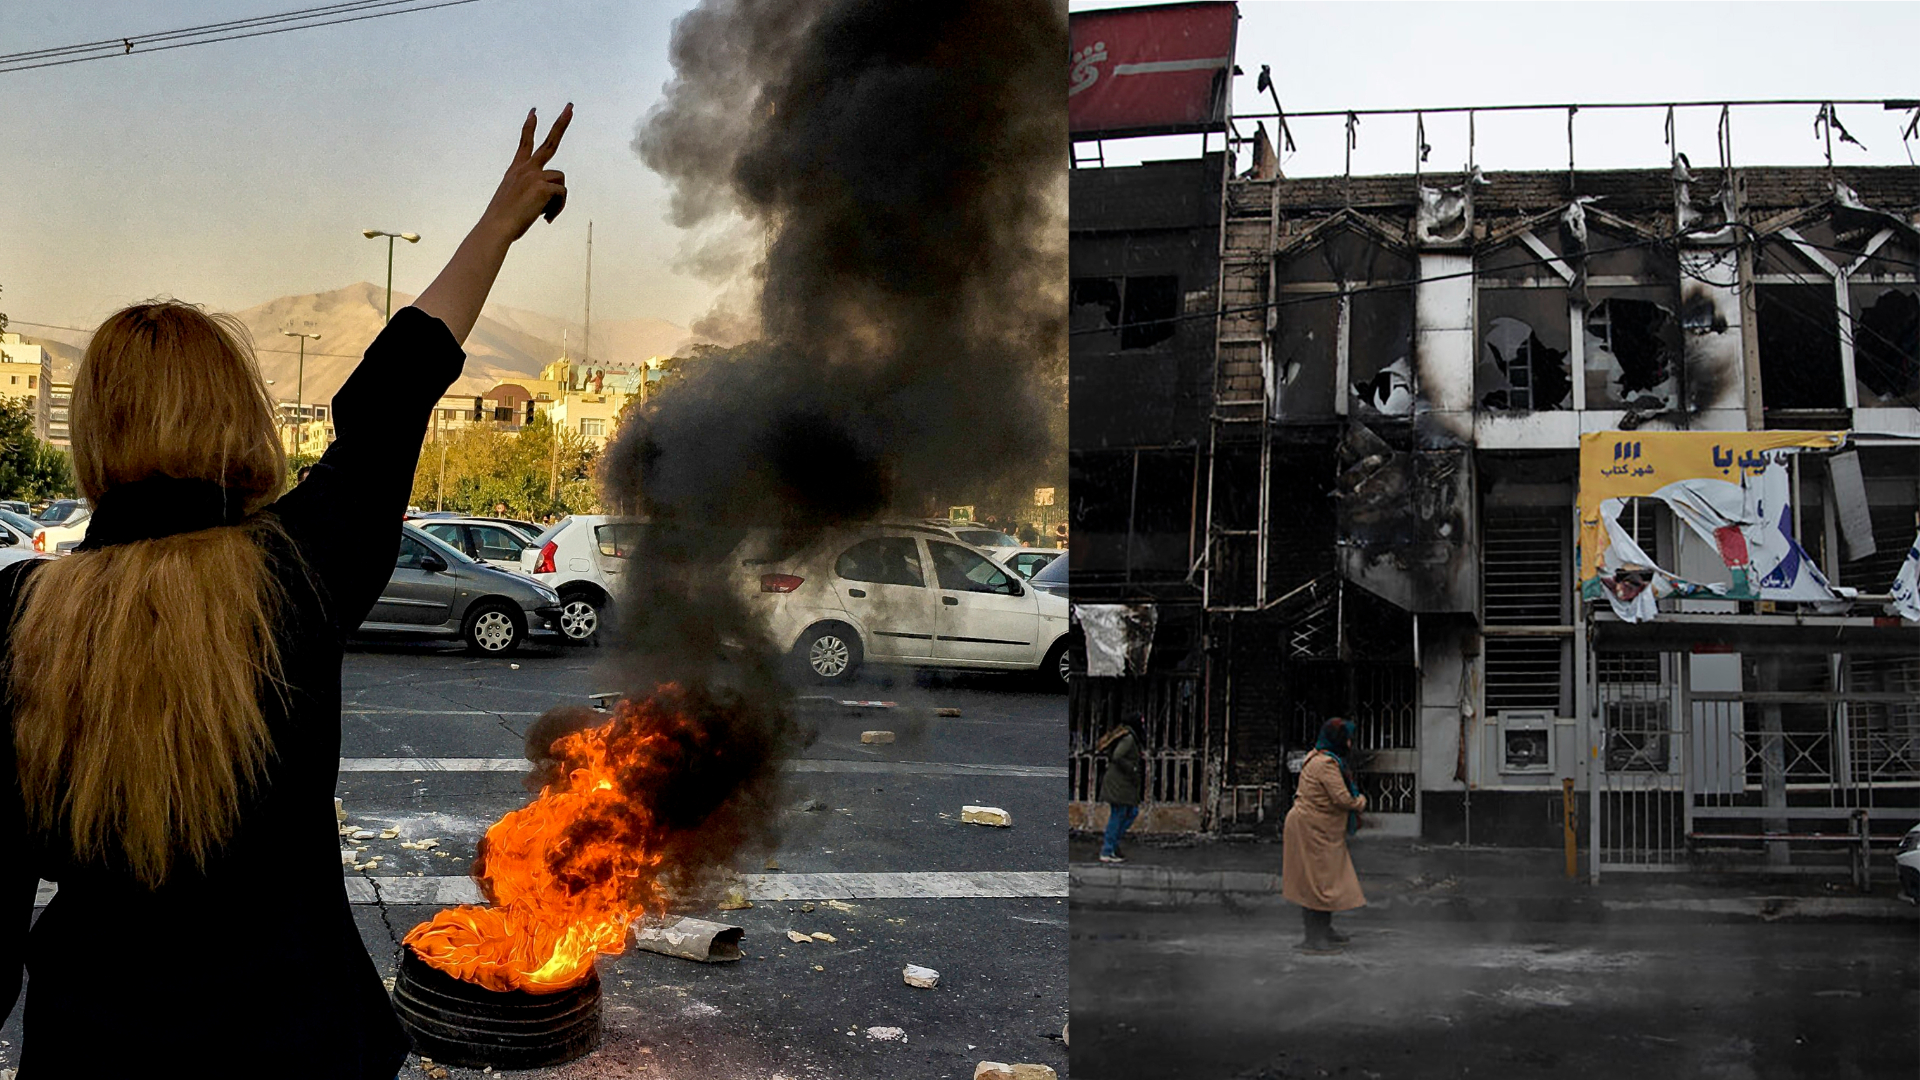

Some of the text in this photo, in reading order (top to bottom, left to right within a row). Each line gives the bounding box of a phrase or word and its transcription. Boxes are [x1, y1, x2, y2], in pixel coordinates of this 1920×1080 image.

[1600, 463, 1655, 478] شهر کتاب
[1712, 445, 1733, 475] با
